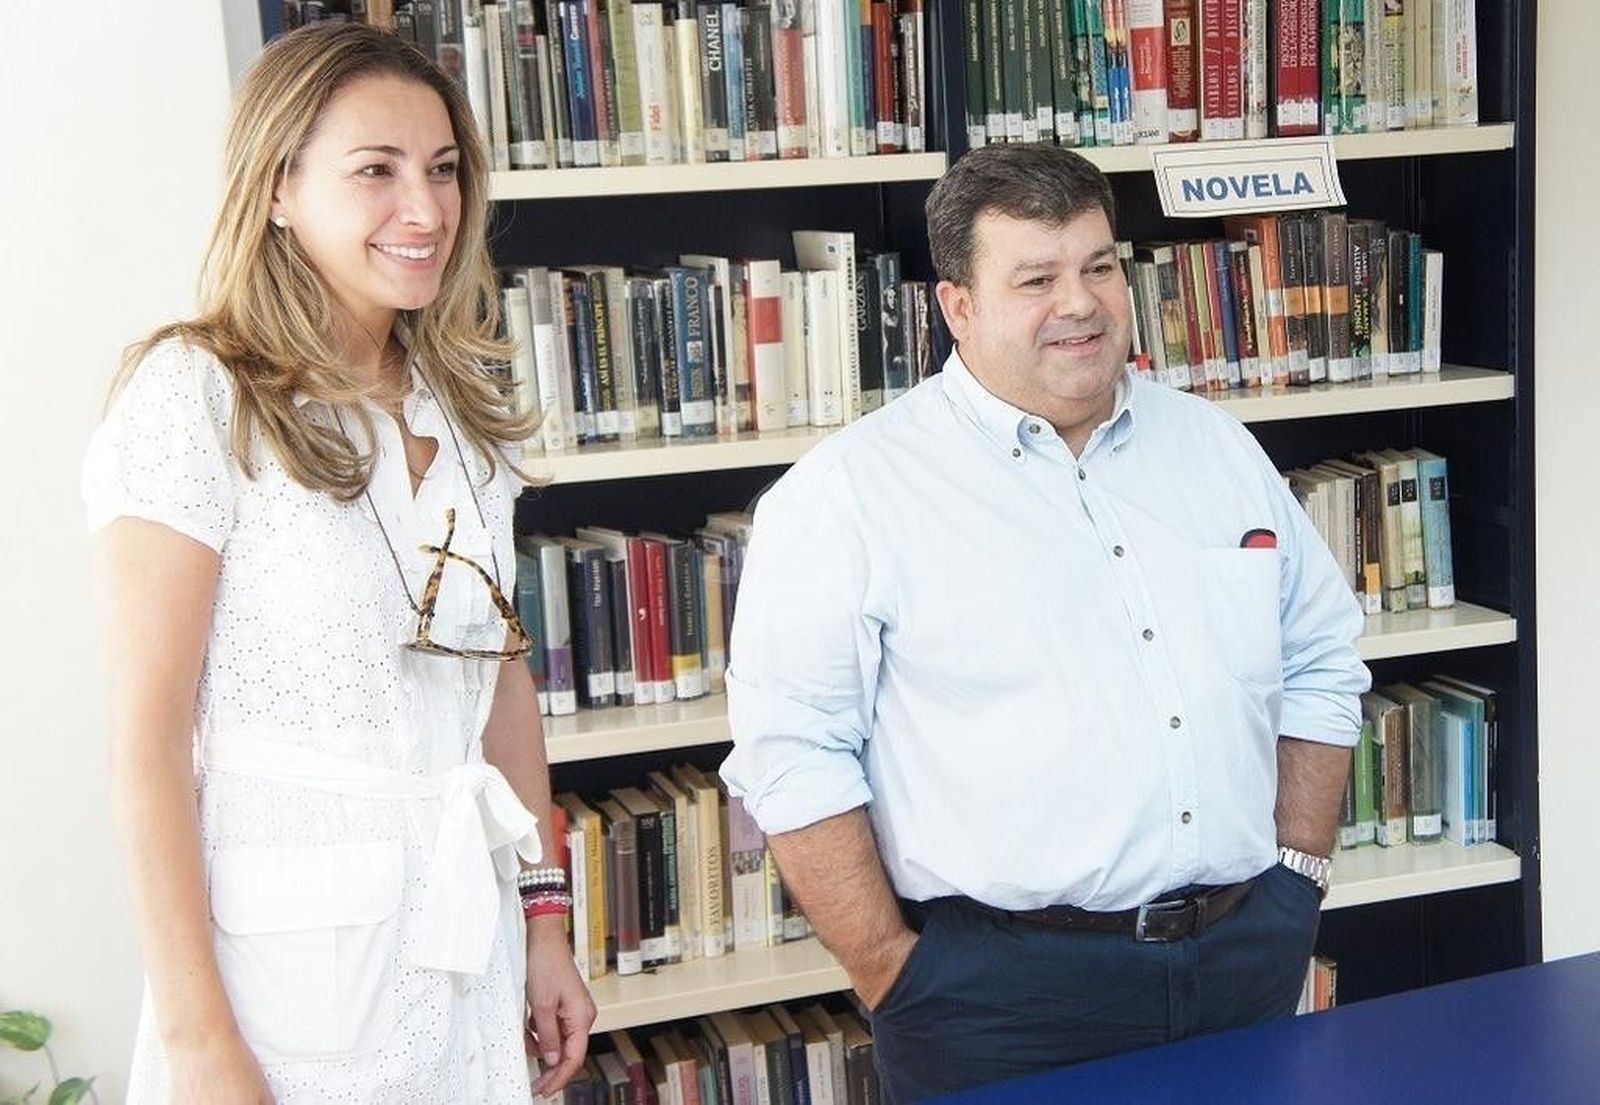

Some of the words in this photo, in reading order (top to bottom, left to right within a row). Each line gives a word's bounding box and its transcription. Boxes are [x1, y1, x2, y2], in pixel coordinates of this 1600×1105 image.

[705, 10, 721, 72] CHANEL
[1181, 171, 1315, 202] NOVELA
[1353, 245, 1362, 286] ALLENDE
[686, 276, 701, 337] FRANCO
[704, 845, 721, 927] FAVORITOS
